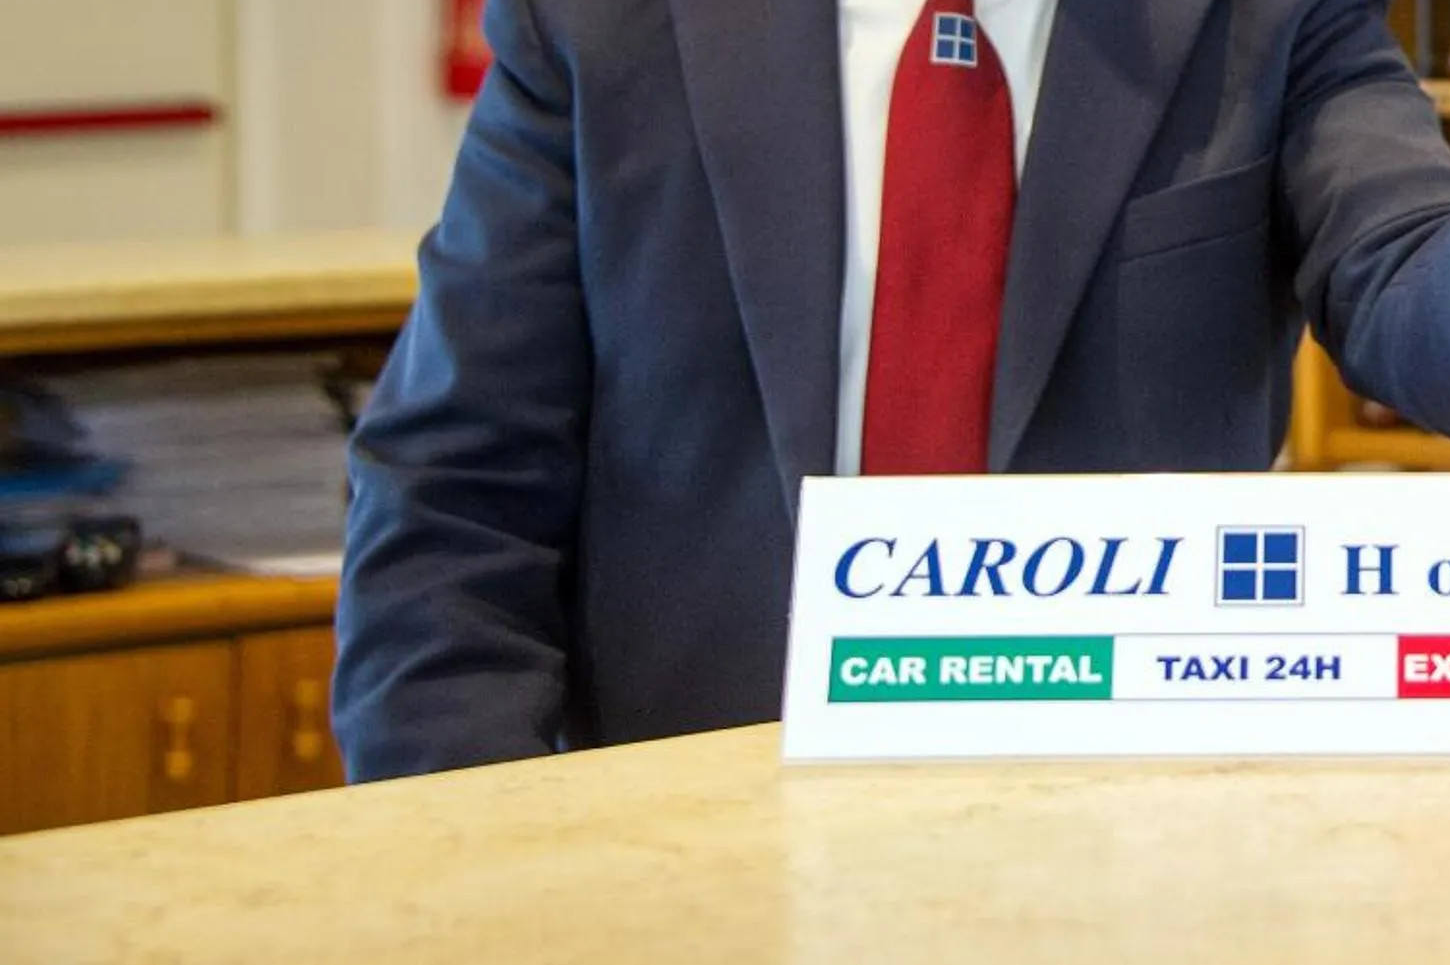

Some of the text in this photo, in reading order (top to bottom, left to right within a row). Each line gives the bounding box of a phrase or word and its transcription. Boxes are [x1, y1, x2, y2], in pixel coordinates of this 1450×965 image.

[834, 537, 1184, 599] CAROLI
[840, 654, 1104, 685] CAR RENTAL
[1156, 655, 1342, 682] TAXI 24H
